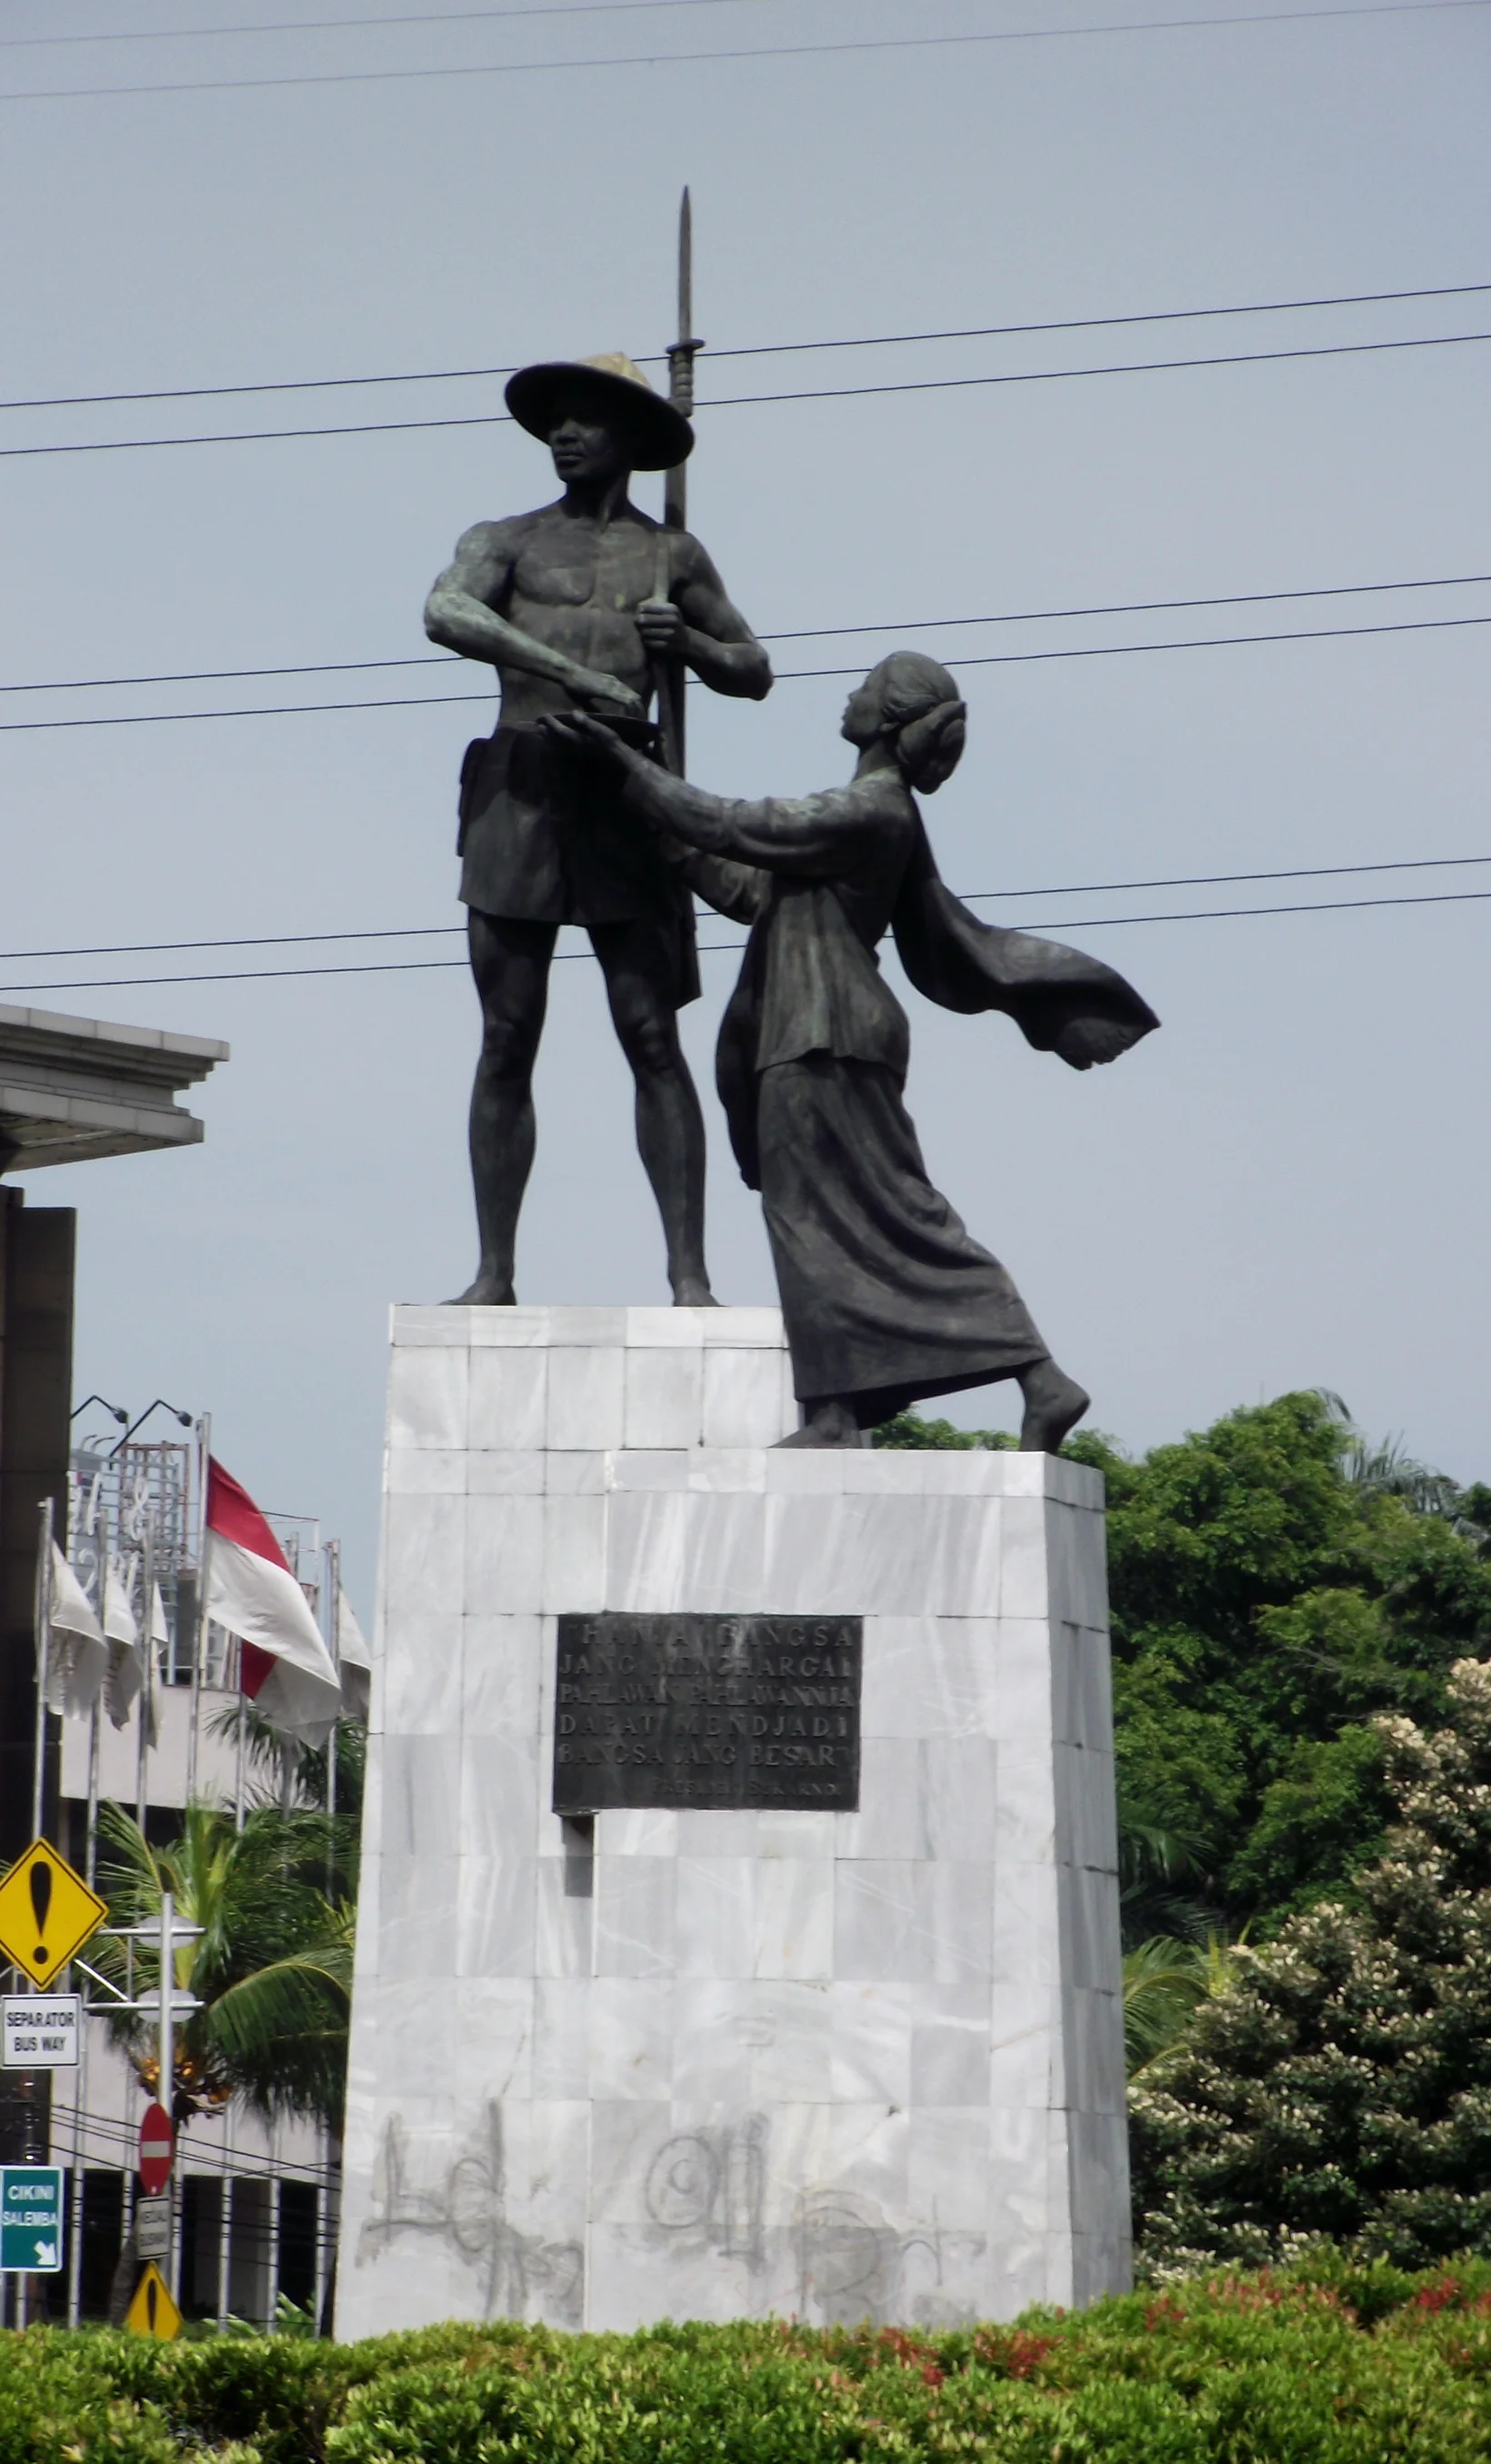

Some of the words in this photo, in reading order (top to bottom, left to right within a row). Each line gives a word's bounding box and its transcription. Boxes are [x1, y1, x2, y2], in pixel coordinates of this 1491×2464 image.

[718, 1623, 853, 1648] BANGSA
[559, 1655, 635, 1676] JANG
[559, 1714, 655, 1736] DAPAT
[675, 1715, 848, 1738] MENDJADI
[557, 1743, 665, 1765] BANGSA
[6, 2011, 75, 2028] SEPARATOR
[14, 2037, 38, 2052] BUS
[42, 2036, 66, 2051] WAY
[7, 2185, 55, 2201] CIKINI
[2, 2210, 58, 2227] SALEMBA
